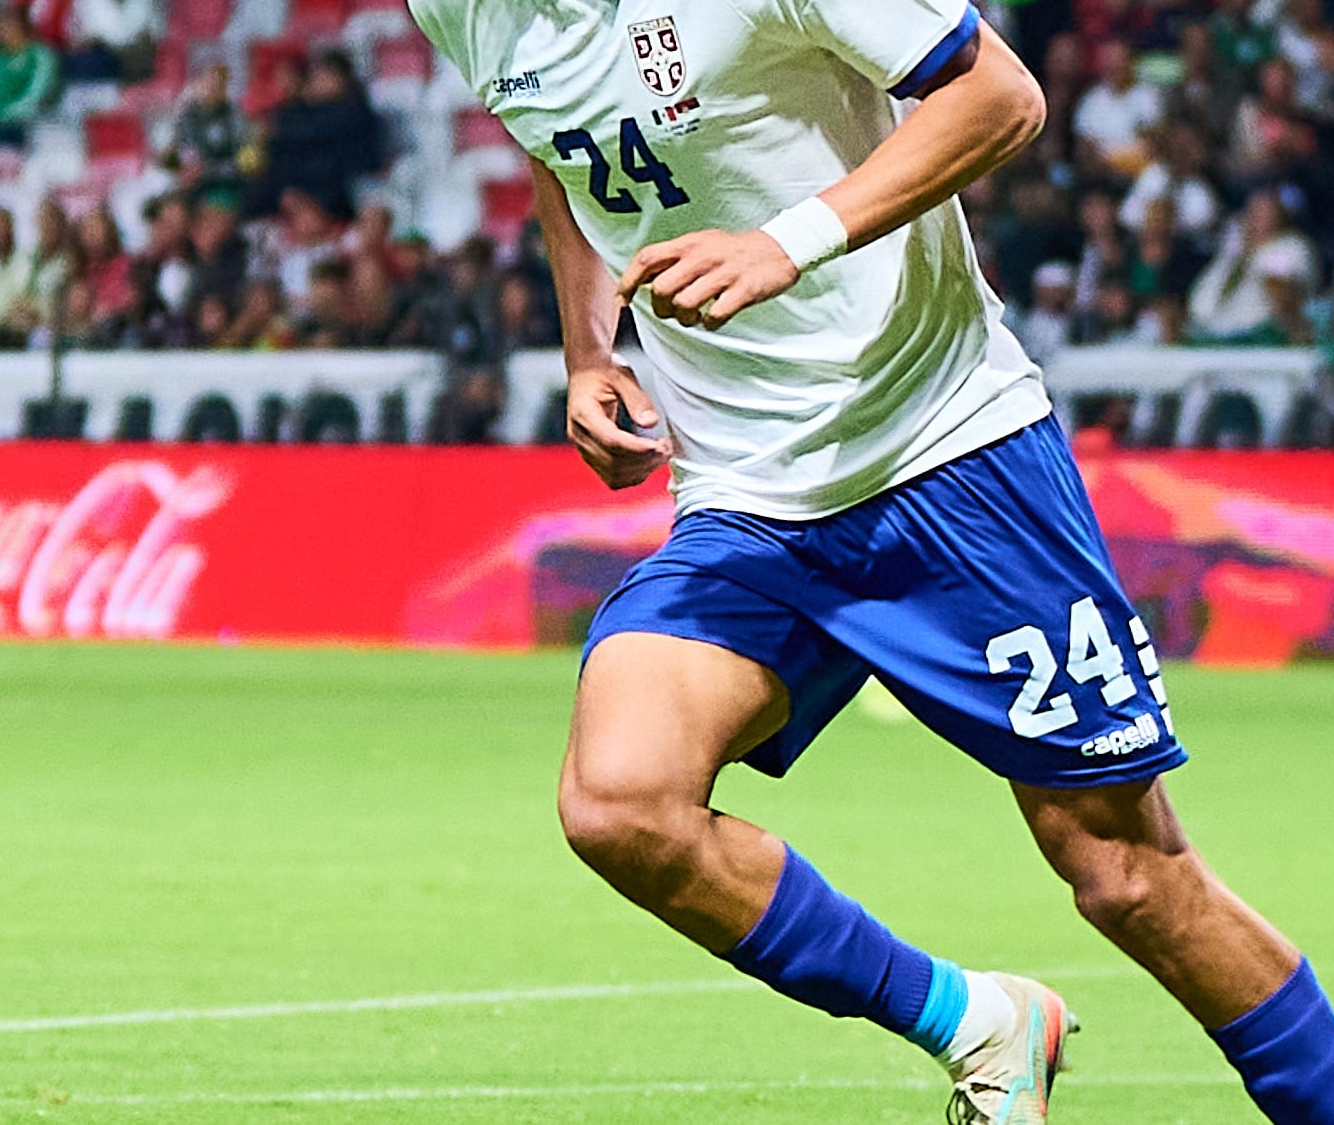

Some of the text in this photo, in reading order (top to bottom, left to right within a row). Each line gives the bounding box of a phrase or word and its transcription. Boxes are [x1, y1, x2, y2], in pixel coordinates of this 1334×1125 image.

[552, 118, 690, 213] 24
[985, 596, 1137, 739] 24
[1080, 712, 1160, 756] capelli
